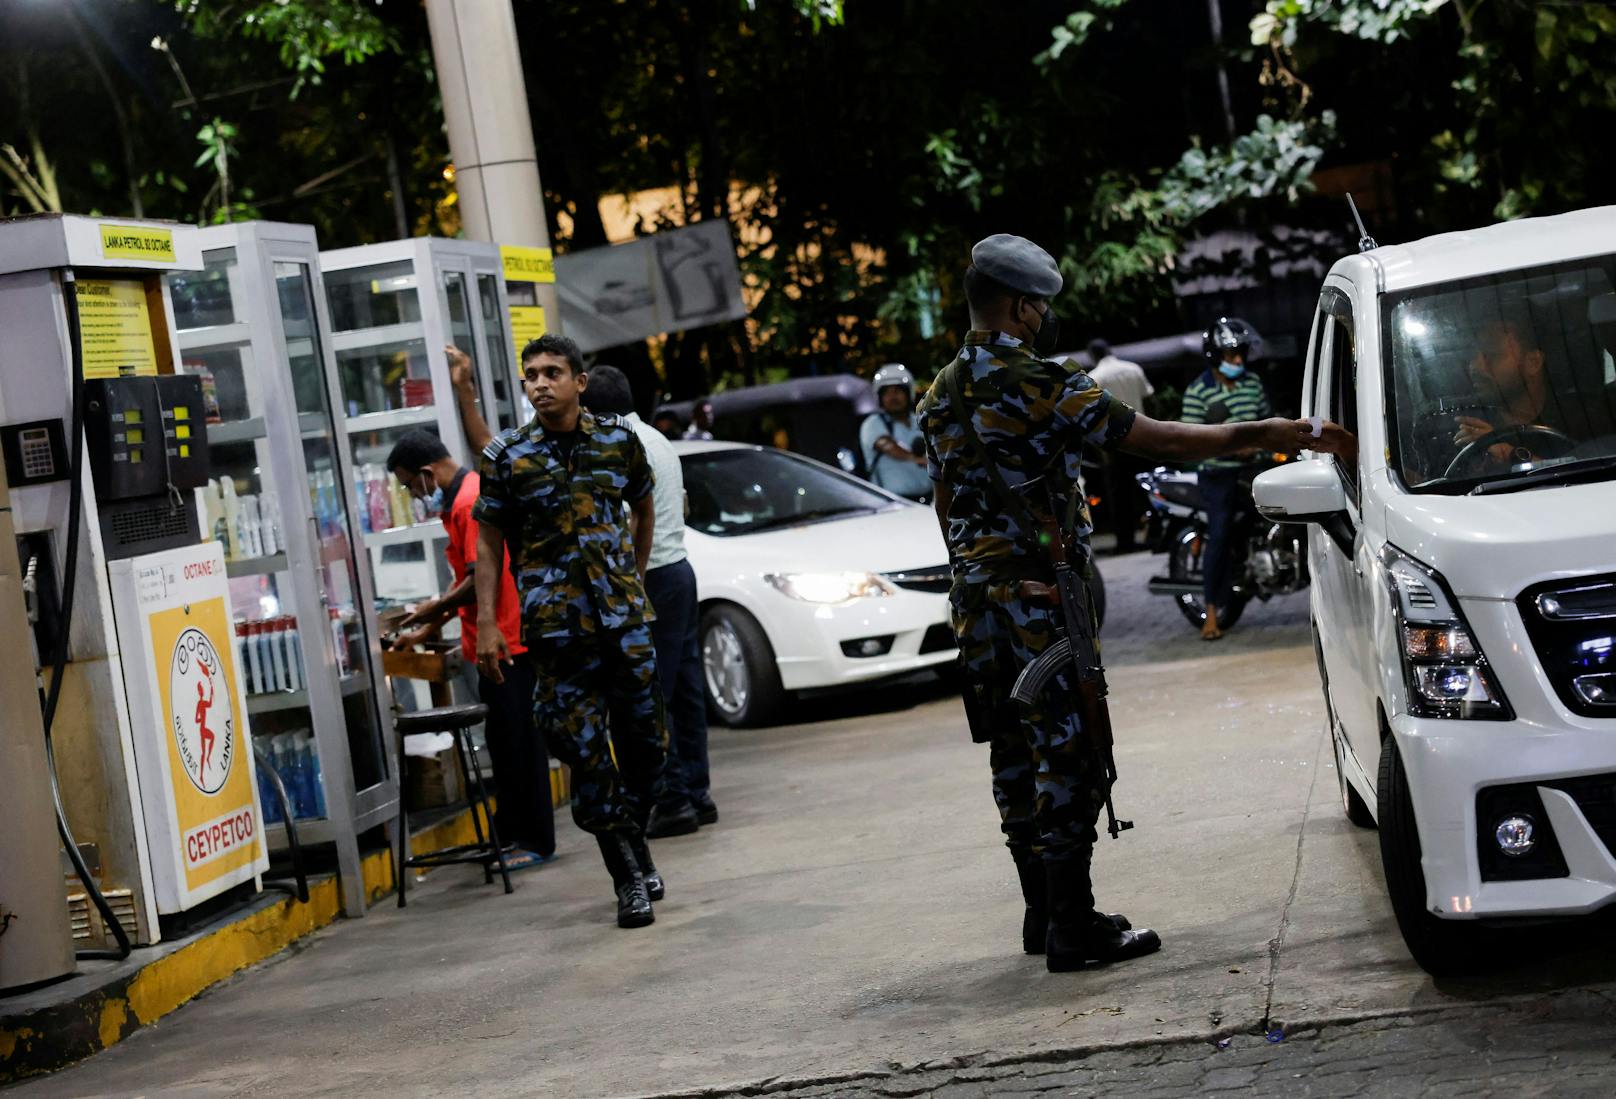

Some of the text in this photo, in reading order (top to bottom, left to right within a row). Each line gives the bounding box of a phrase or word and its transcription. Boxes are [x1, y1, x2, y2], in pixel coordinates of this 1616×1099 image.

[105, 236, 123, 248] LANKA
[123, 237, 145, 250] PETROL
[151, 240, 171, 252] OCTANE
[183, 560, 212, 580] OCTANE
[220, 719, 231, 771] LANKA
[187, 811, 253, 863] CEYPETCO
